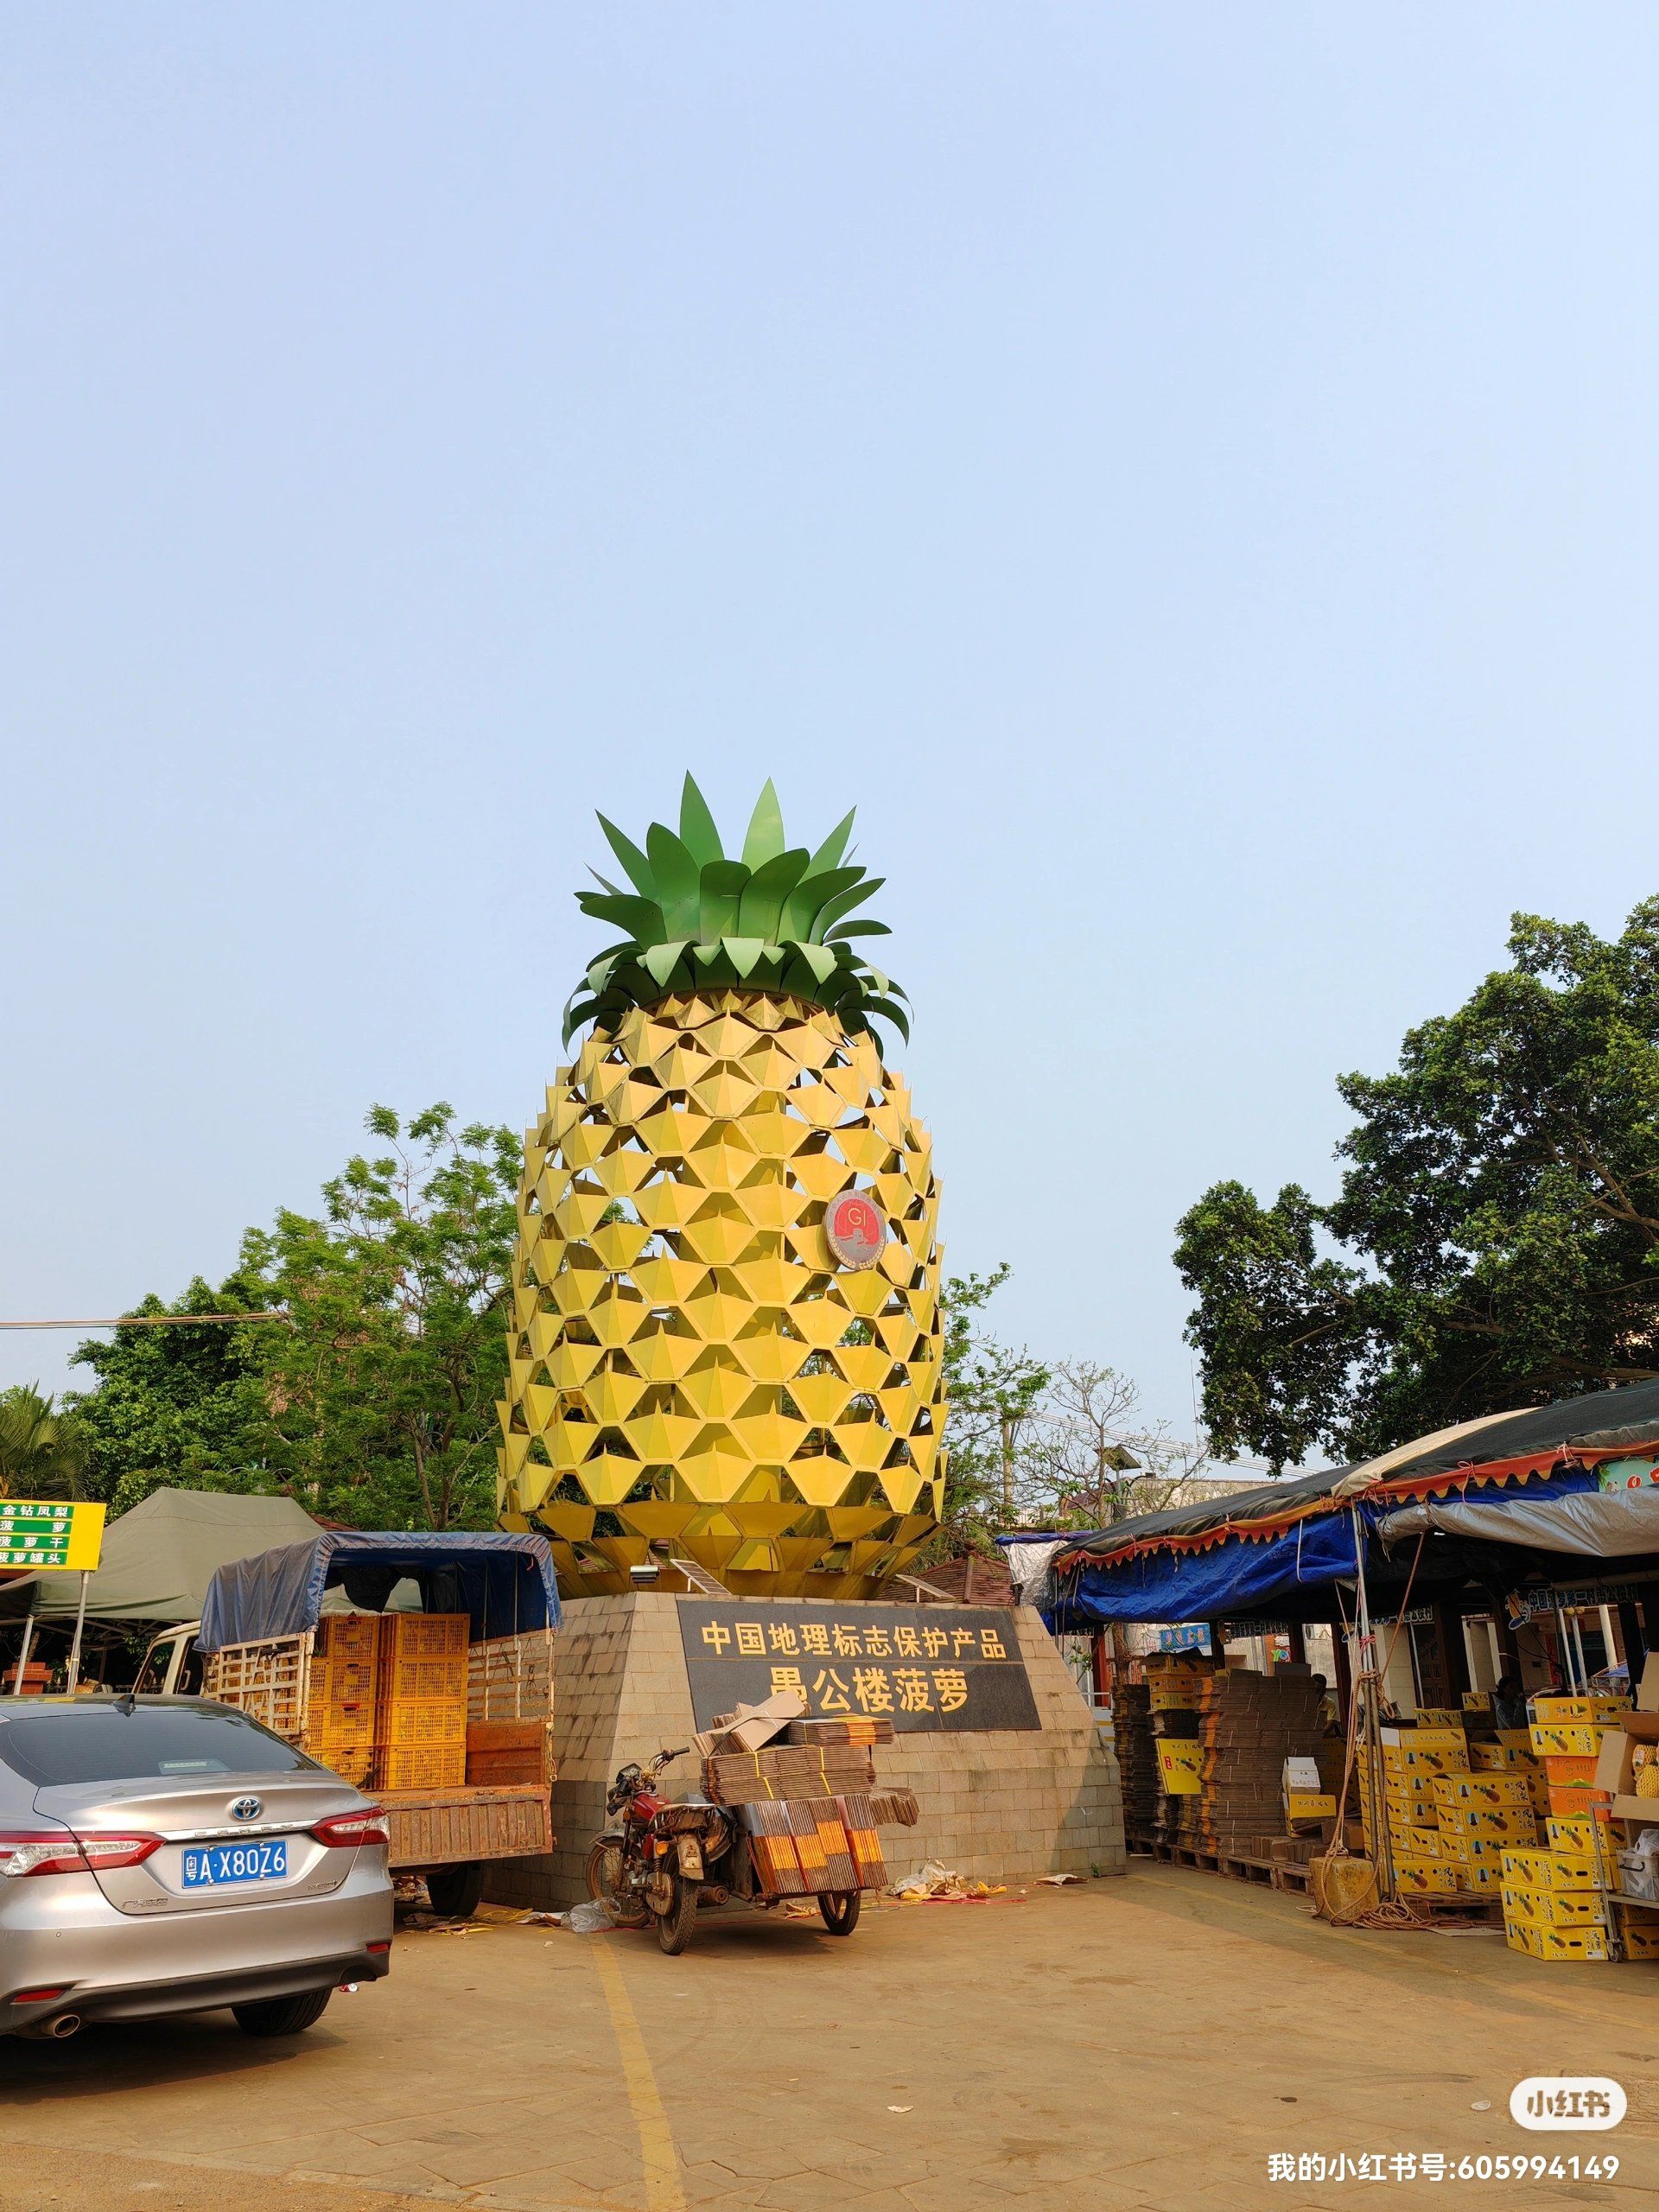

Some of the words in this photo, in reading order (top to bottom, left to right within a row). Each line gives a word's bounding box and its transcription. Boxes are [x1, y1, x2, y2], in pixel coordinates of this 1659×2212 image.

[3, 1504, 68, 1517] 金钻凤梨
[0, 1536, 64, 1548] 菠萝干
[701, 1620, 1007, 1659] 中国地理标志保护产品
